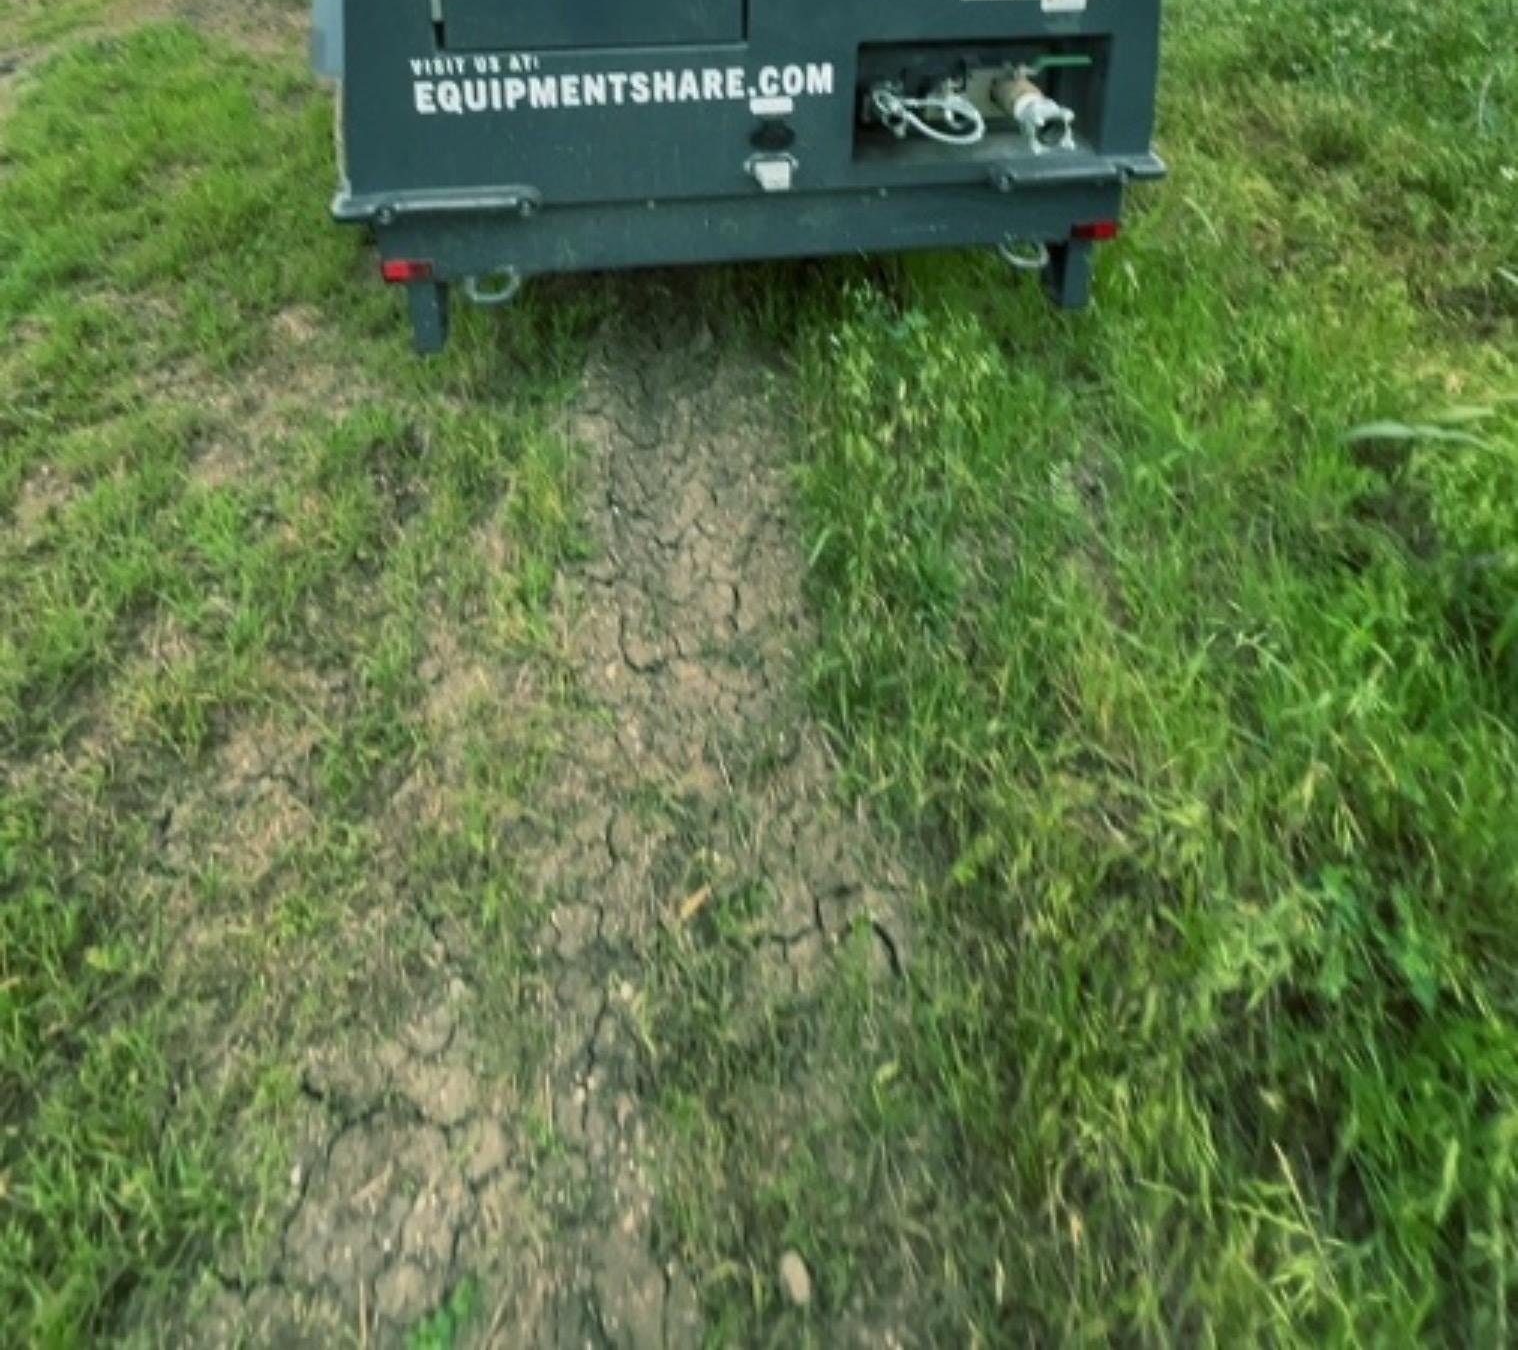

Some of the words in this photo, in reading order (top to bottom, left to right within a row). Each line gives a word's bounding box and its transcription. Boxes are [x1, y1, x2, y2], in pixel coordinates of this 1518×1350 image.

[409, 56, 465, 75] VISIT
[473, 54, 500, 73] US
[508, 53, 539, 72] AT:
[413, 62, 834, 115] EQUIPMENTSHARE.COM
